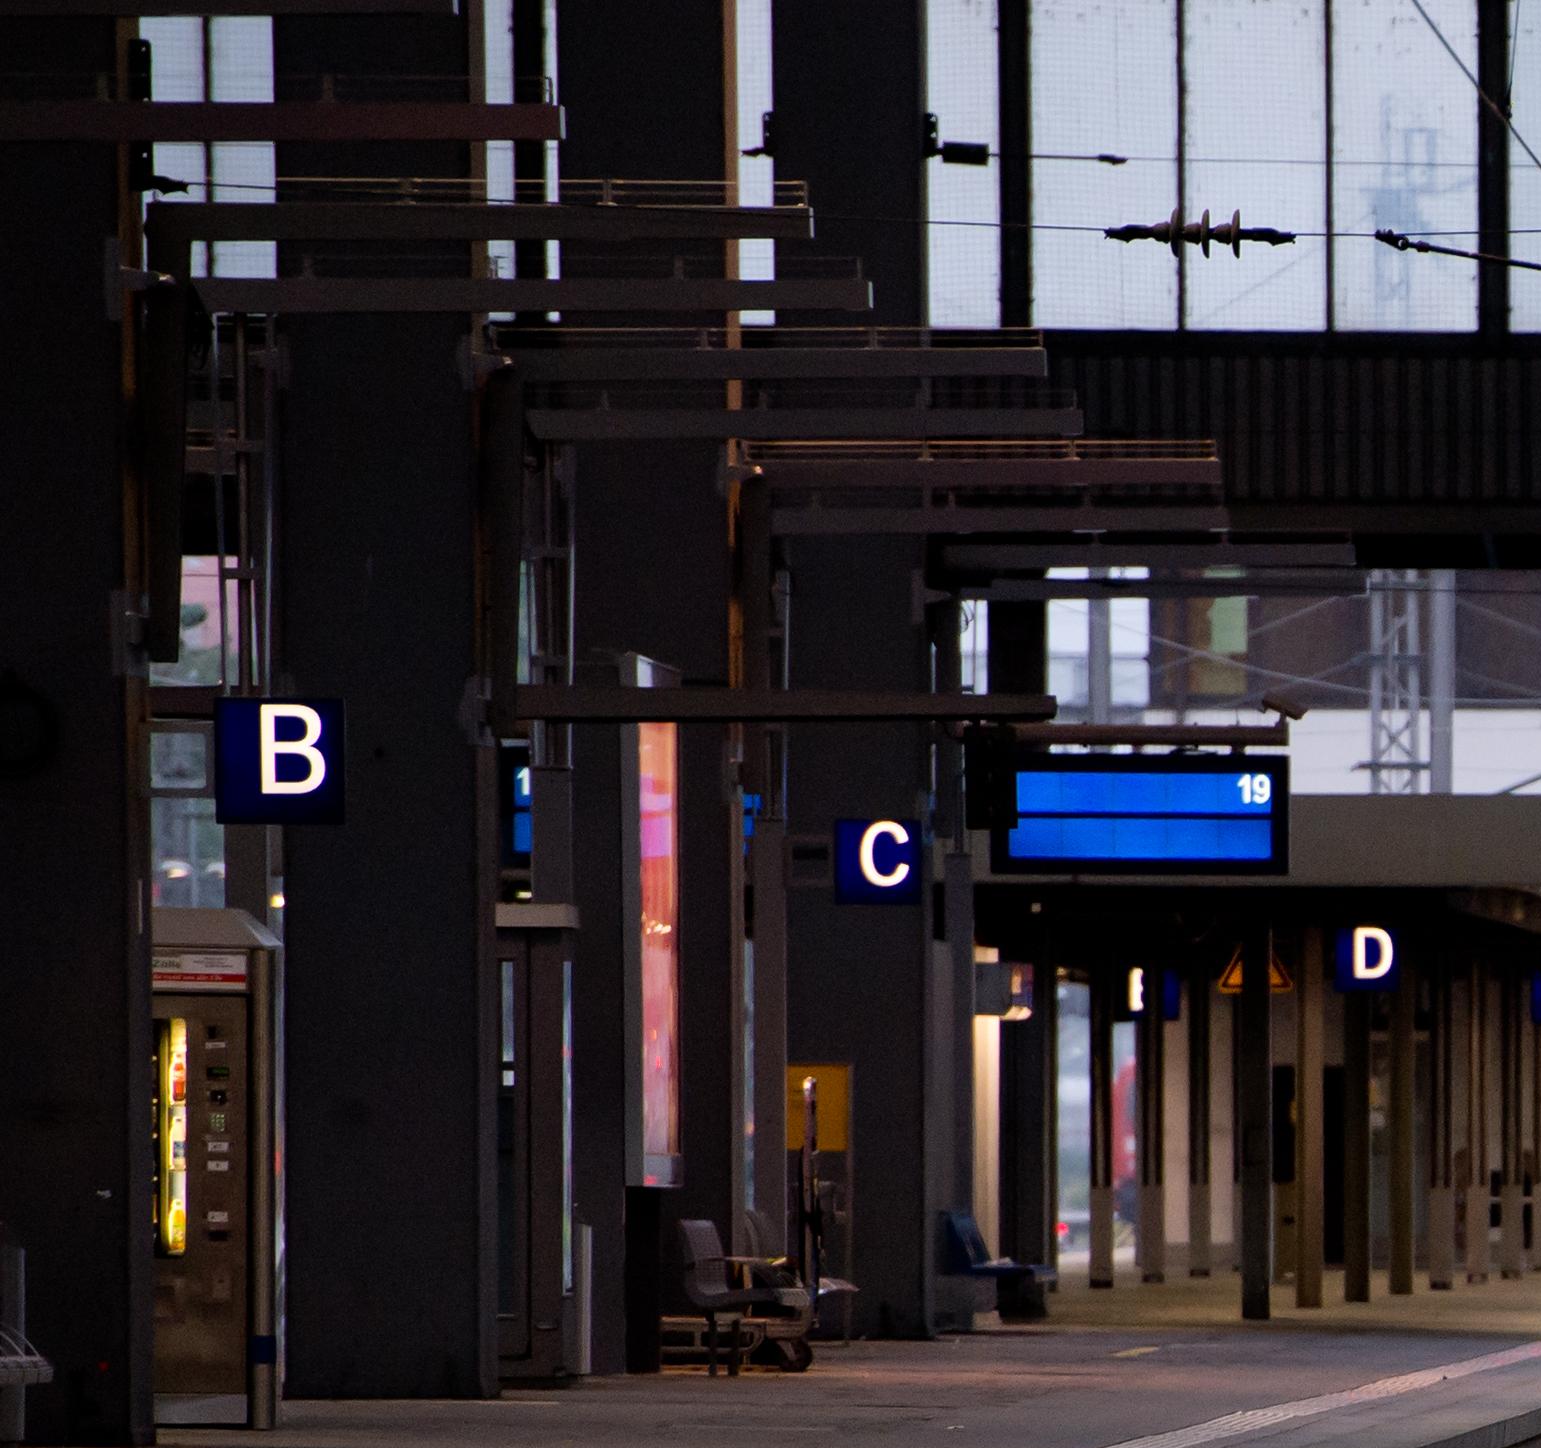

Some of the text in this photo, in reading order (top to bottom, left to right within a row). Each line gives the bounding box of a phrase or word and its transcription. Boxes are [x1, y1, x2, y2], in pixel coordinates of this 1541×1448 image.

[259, 703, 326, 795] B
[1237, 774, 1271, 804] 19
[859, 820, 910, 887] C
[1353, 926, 1394, 979] D
